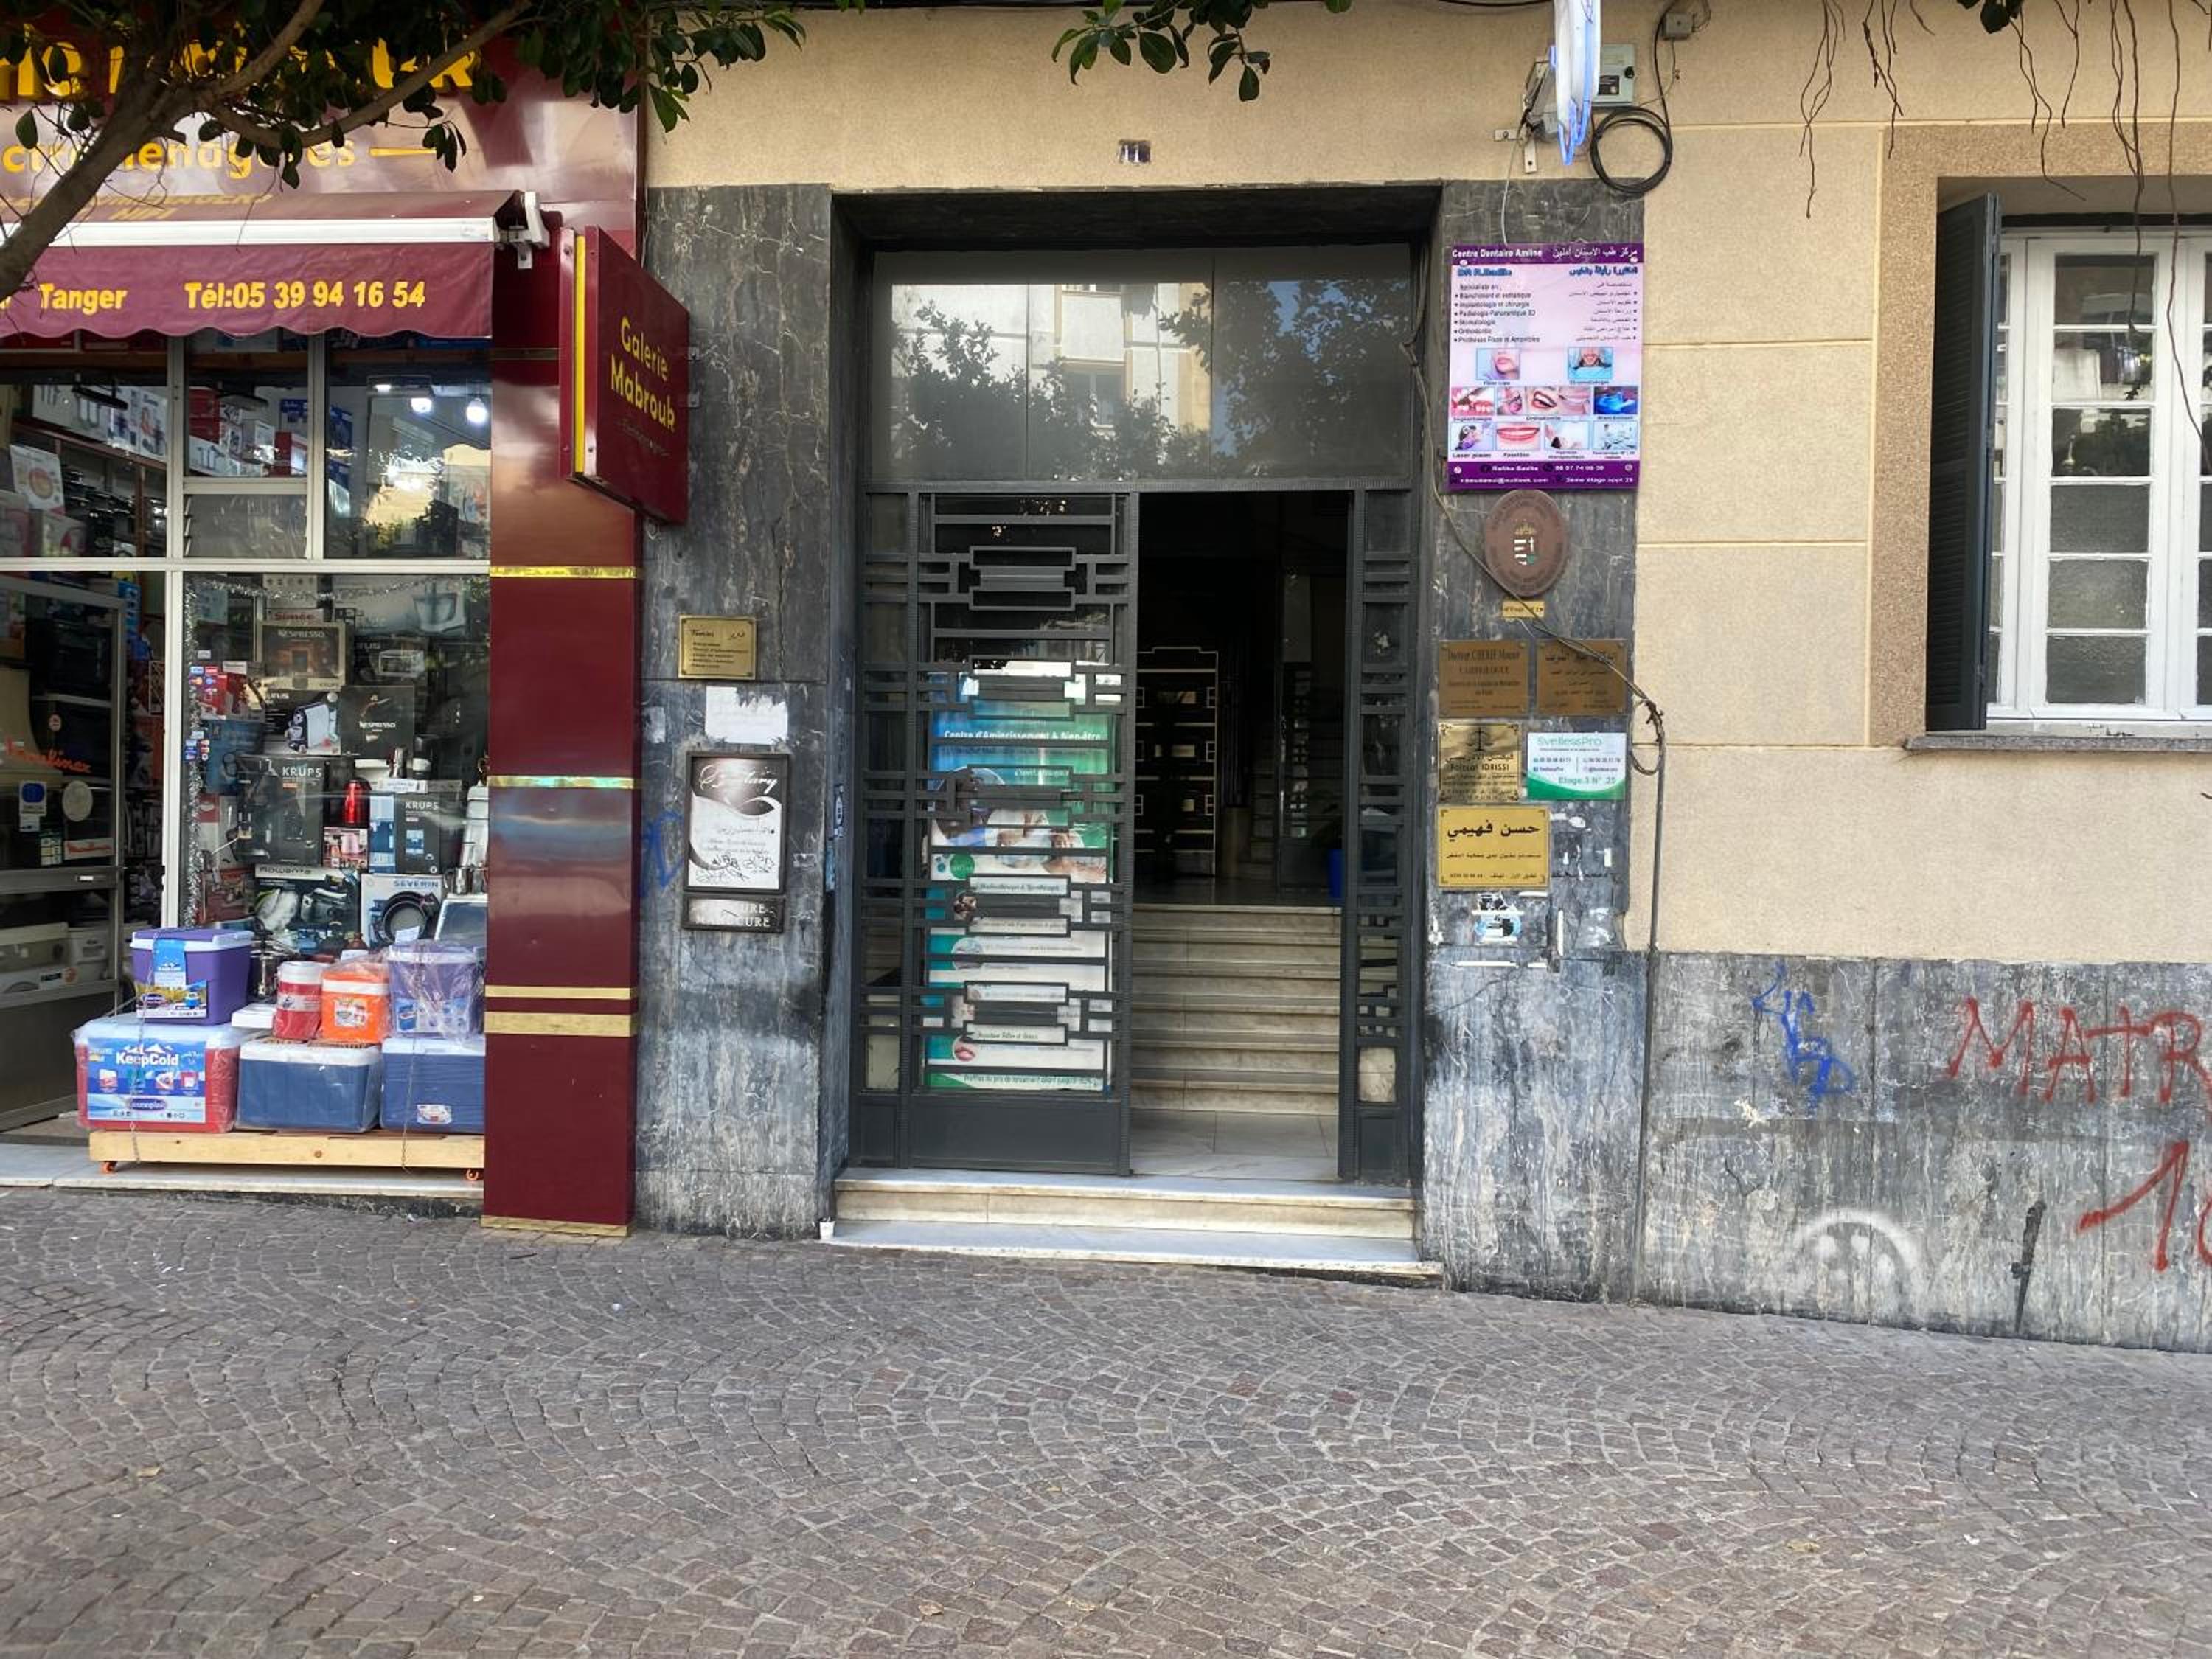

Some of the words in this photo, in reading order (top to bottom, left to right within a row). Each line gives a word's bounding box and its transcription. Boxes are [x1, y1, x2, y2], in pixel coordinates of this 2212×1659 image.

[39, 283, 127, 315] Tanger
[184, 282, 266, 308] Tél:05
[274, 282, 306, 308] 39
[313, 281, 344, 307] 94
[354, 282, 384, 307] 16
[393, 282, 425, 307] 54
[620, 316, 668, 382] Galerie
[611, 354, 676, 434] Mabrouk
[277, 629, 325, 639] NESPRESSO
[282, 765, 322, 779] KRUPS
[1481, 763, 1510, 771] IDRISSI
[405, 801, 439, 811] KRUPS
[1447, 819, 1493, 842] فهيمي
[1500, 824, 1541, 837] حسن
[258, 866, 313, 875] Rowenta
[393, 879, 440, 889] SEVERIN
[116, 1051, 180, 1068] KeepCold
